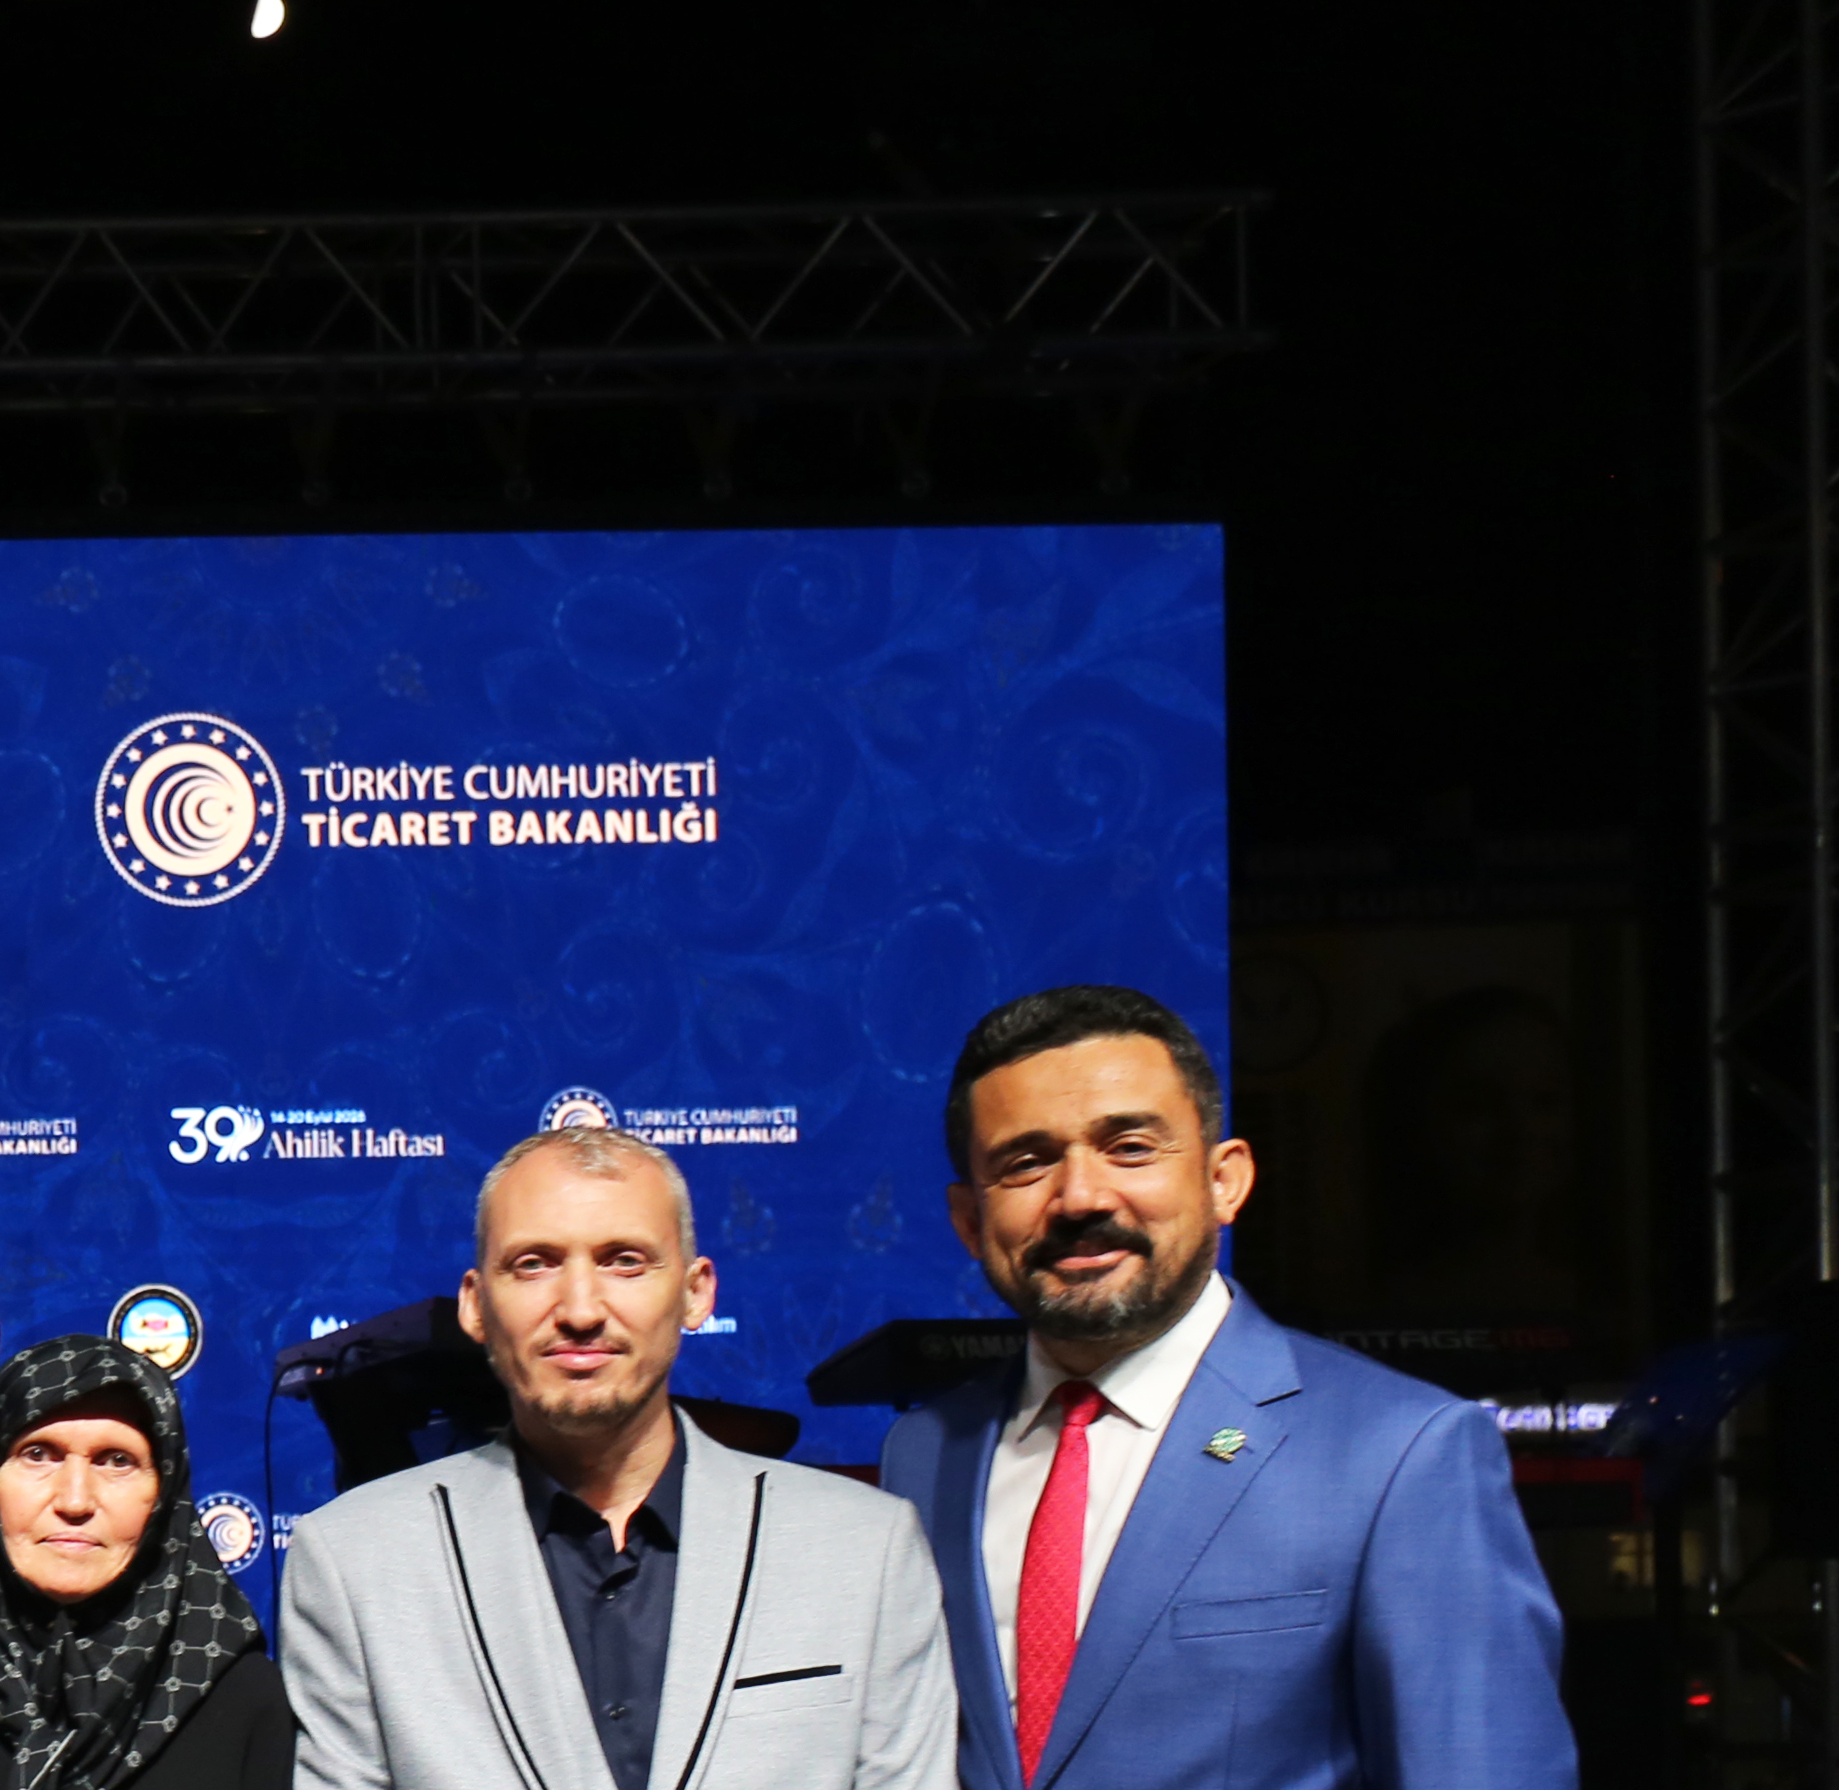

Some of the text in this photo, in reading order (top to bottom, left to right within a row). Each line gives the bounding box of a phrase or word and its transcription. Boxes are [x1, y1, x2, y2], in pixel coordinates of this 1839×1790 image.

[300, 756, 718, 803] TÜRKİYE CUMHURİYETİ
[300, 800, 720, 848] TİCARET BAKANLIĞI
[263, 1127, 446, 1159] Ahilik Haftası
[700, 1124, 798, 1145] BAKANLIĞI
[950, 1333, 1026, 1360] YAMA
